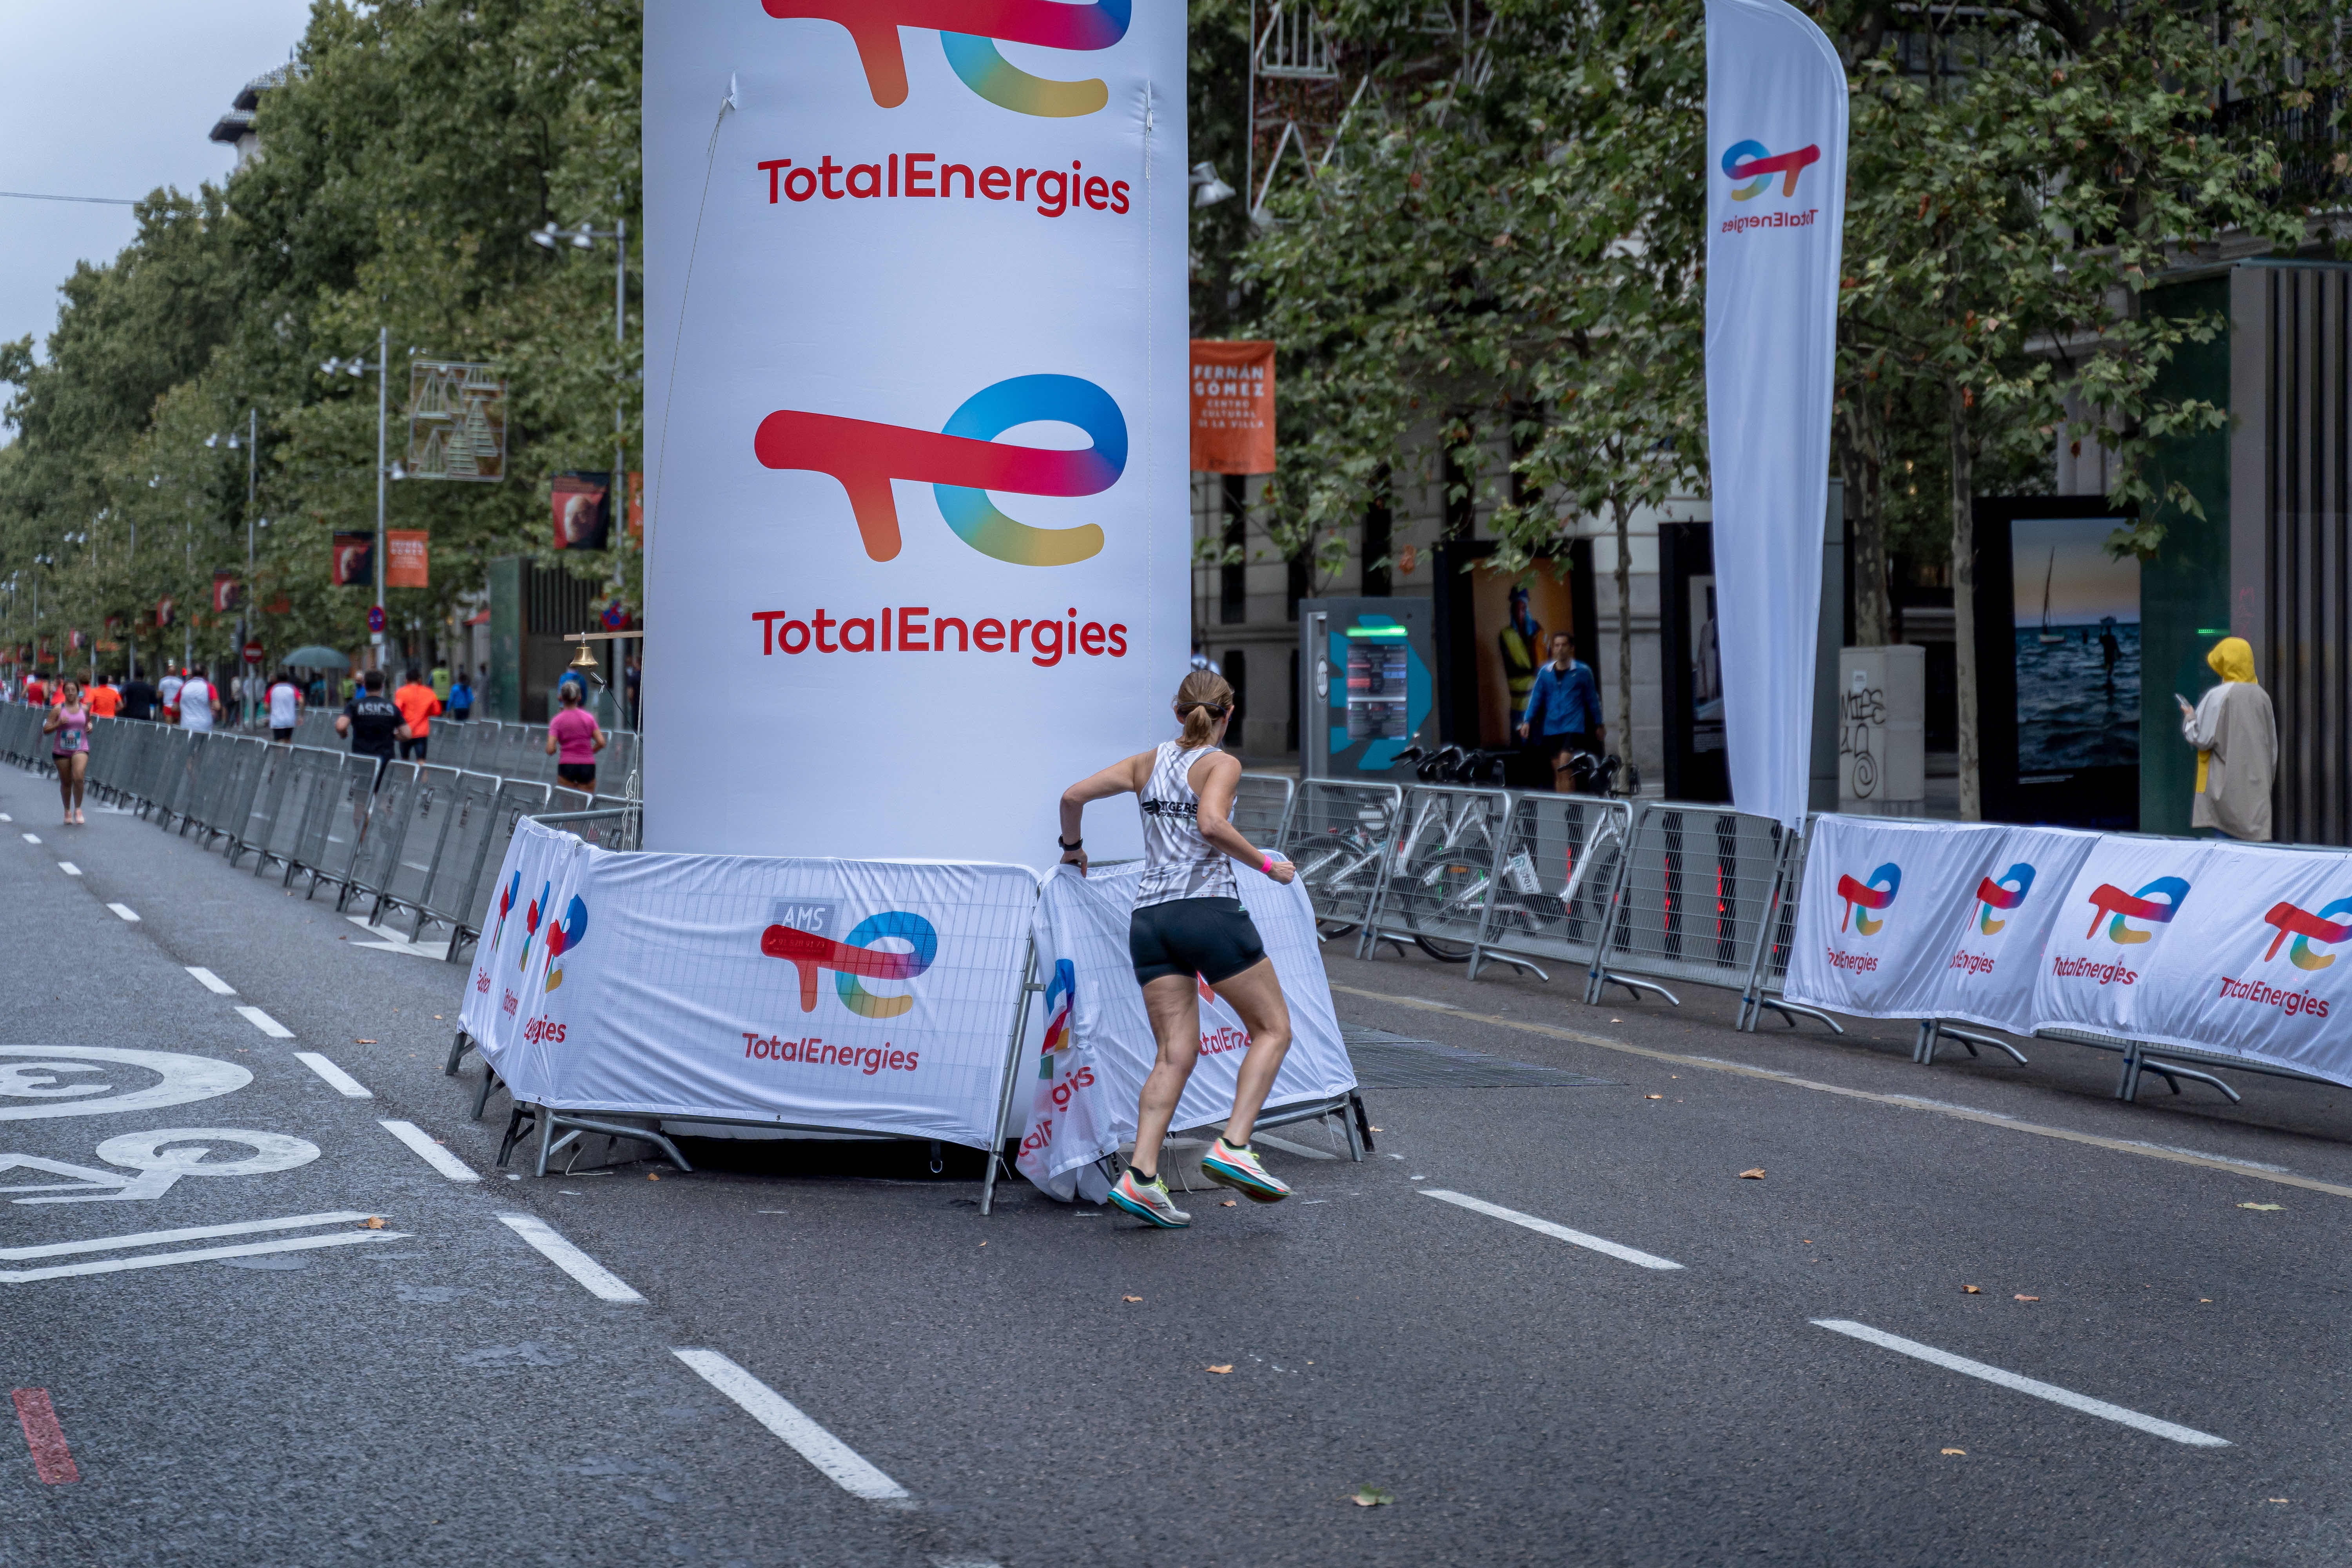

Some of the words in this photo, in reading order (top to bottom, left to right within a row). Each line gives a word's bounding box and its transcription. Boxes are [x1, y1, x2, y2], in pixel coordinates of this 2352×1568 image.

[757, 153, 1130, 218] TotalEnergies
[1193, 363, 1264, 379] FERNÁN
[1193, 379, 1264, 397] GÓMEZ
[752, 607, 1127, 667] TotalEnergies
[357, 702, 394, 715] ASICS
[782, 906, 826, 931] AMS
[742, 1033, 919, 1075] TotalEnergies
